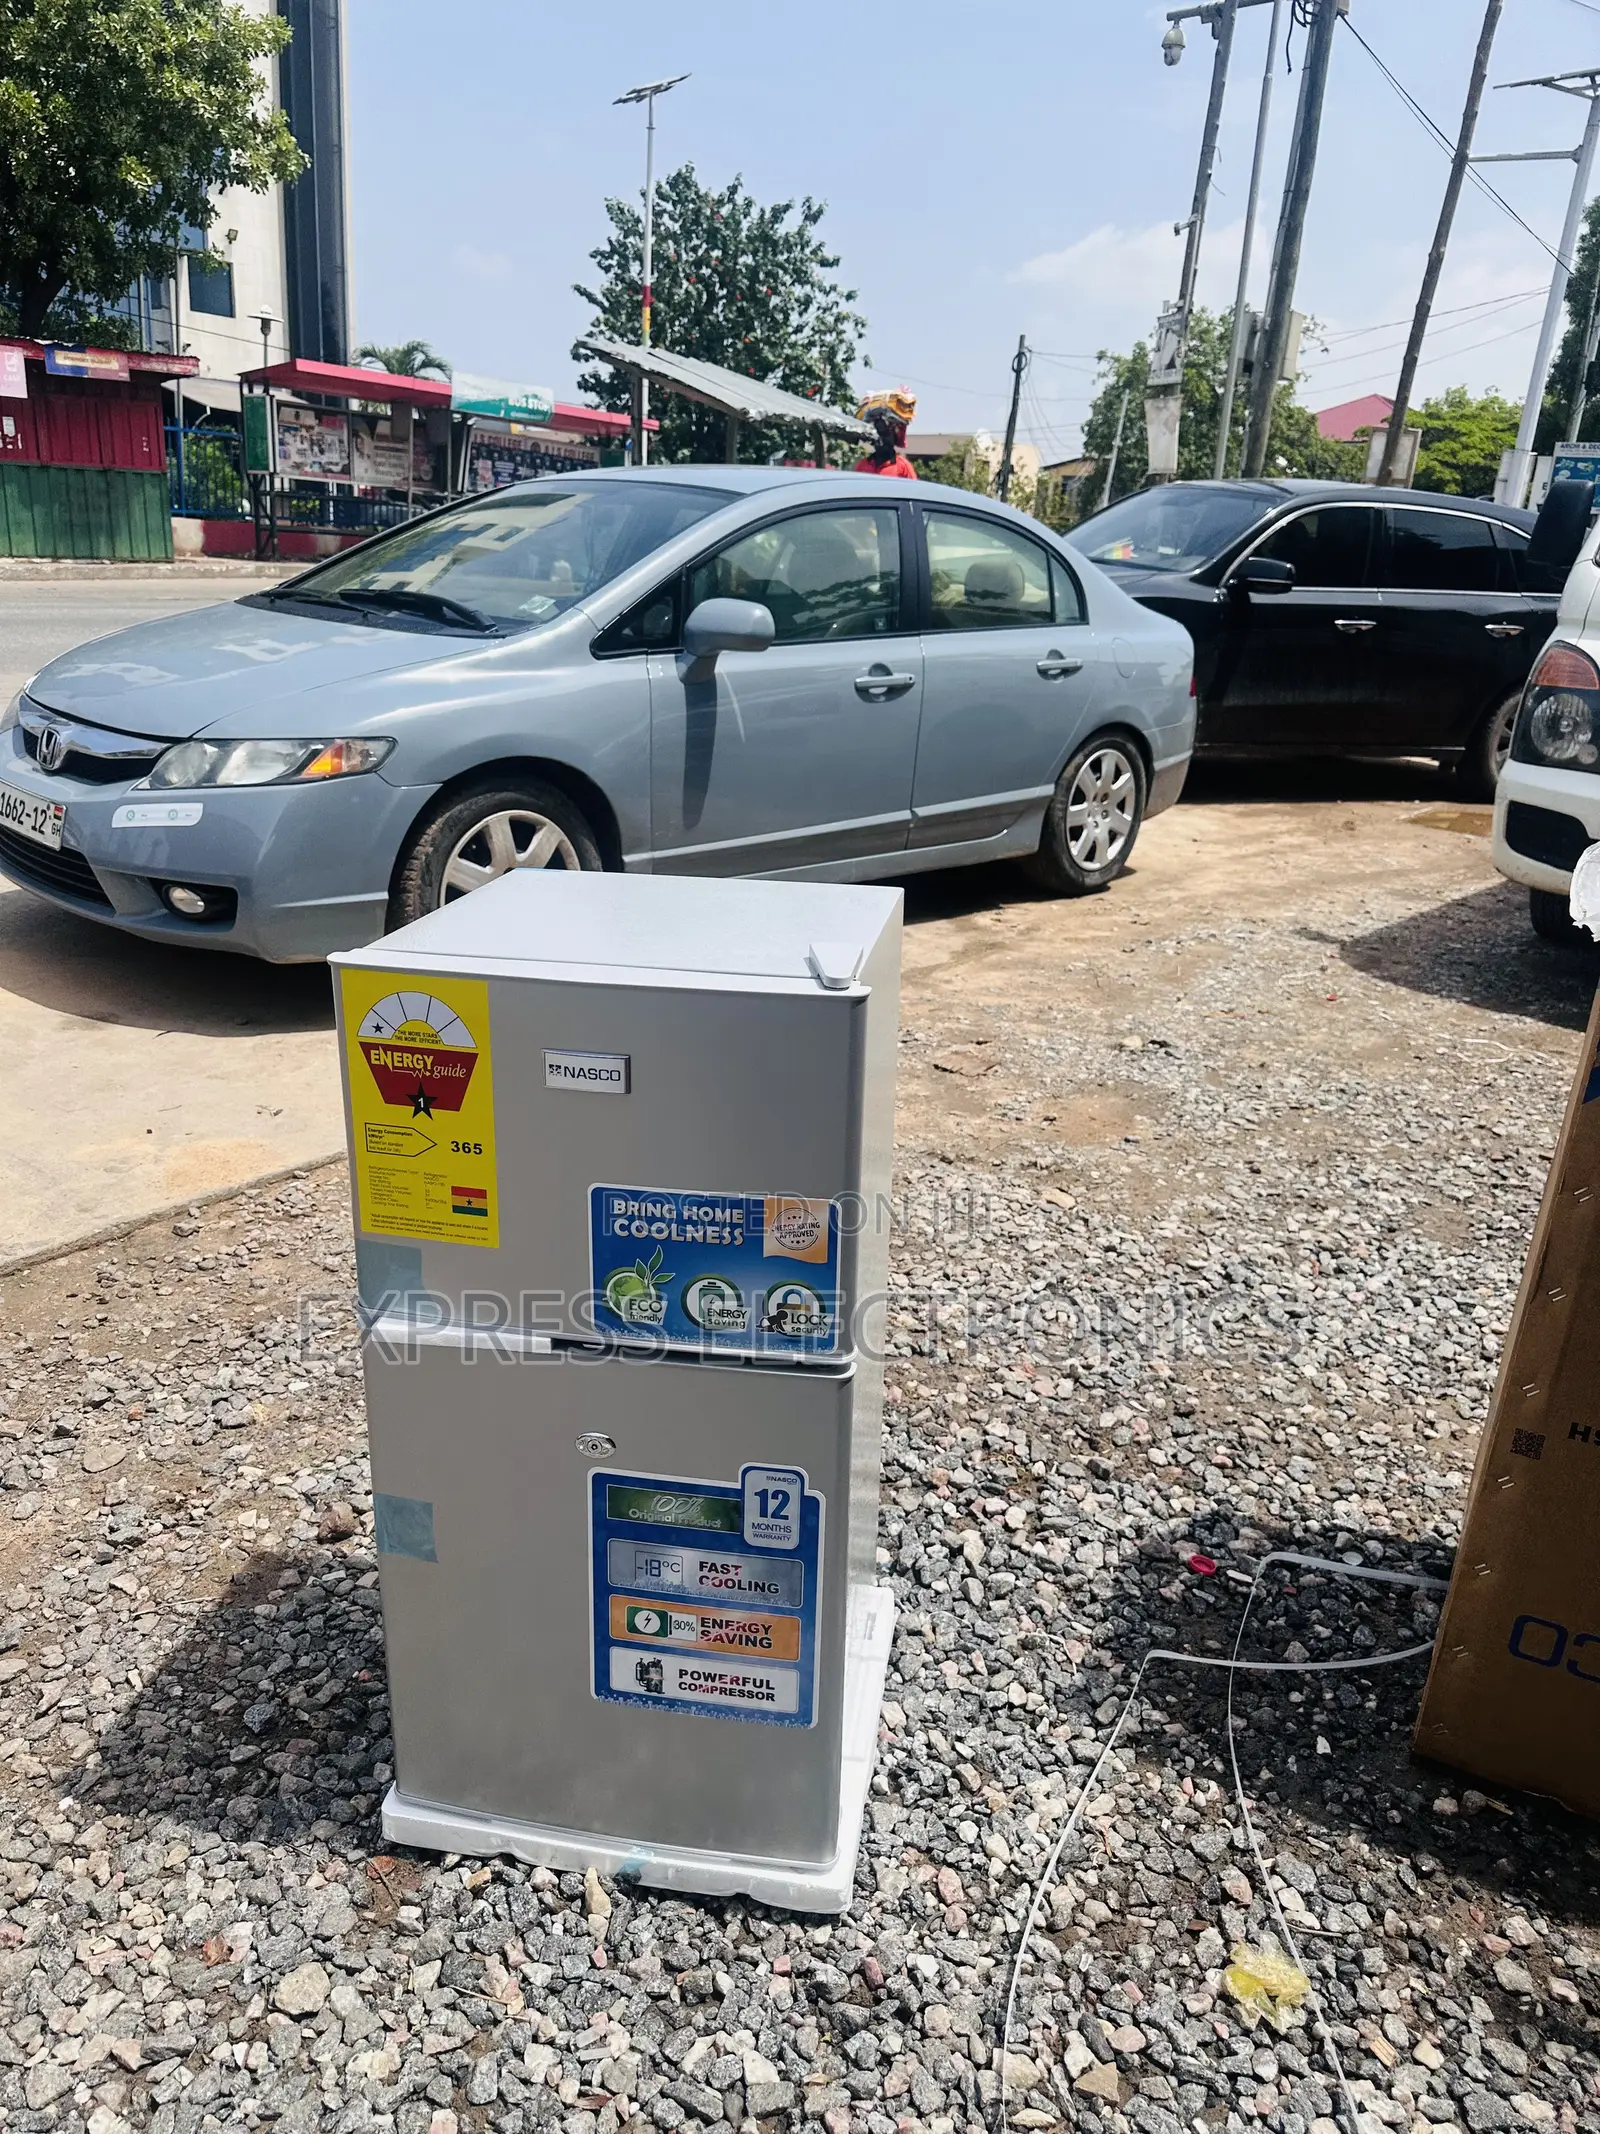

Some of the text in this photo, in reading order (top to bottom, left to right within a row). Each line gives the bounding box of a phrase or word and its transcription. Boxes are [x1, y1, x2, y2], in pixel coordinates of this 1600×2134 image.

[507, 396, 527, 408] BUS
[51, 823, 62, 837] GH
[370, 1045, 467, 1079] ENERGY guide
[563, 1065, 621, 1082] NASCO
[418, 1097, 424, 1108] 1
[450, 1140, 483, 1155] 365
[613, 1199, 744, 1224] BRING HOME
[613, 1218, 744, 1246] COOLNESS
[771, 1221, 821, 1232] NERGY RATING
[779, 1229, 815, 1239] APPROVED
[629, 1299, 663, 1313] ECO
[629, 1312, 663, 1324] friendly
[707, 1307, 748, 1320] ENERGY
[790, 1313, 828, 1326] LOCK
[707, 1319, 746, 1330] saving
[790, 1325, 829, 1337] security
[771, 1476, 798, 1484] NASCO
[650, 1494, 705, 1514] 100%
[754, 1488, 791, 1521] 12
[628, 1508, 721, 1528] Original Product
[751, 1522, 792, 1533] MONTHS
[752, 1532, 791, 1542] WARRANTY
[698, 1560, 743, 1576] FAST
[698, 1575, 780, 1594] COOLING
[673, 1619, 696, 1633] 30%
[700, 1616, 773, 1635] ENERGY
[700, 1629, 773, 1649] SAVING
[678, 1668, 776, 1690] POWERFUL
[678, 1681, 776, 1702] COMPRESSOR
